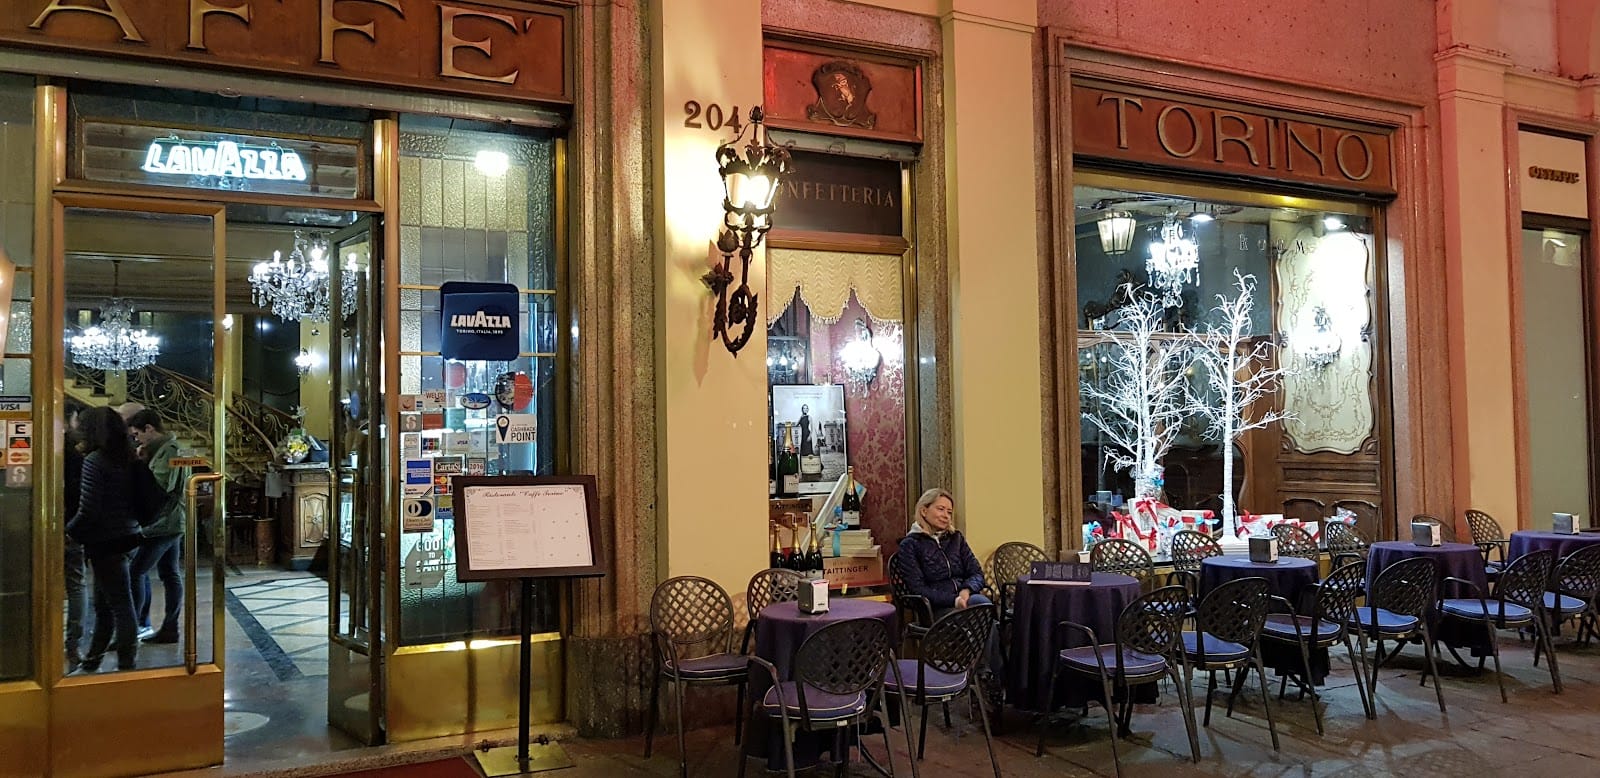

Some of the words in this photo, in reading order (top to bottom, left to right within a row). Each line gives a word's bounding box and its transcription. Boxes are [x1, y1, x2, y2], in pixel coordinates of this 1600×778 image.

[684, 100, 742, 134] 204
[1098, 93, 1374, 182] TORINO
[143, 141, 307, 181] LAVAZZA
[780, 181, 894, 207] NFETTERIA
[450, 310, 512, 328] LAVAZZA
[511, 431, 536, 442] POINT
[822, 565, 869, 576] TAITTINGER
